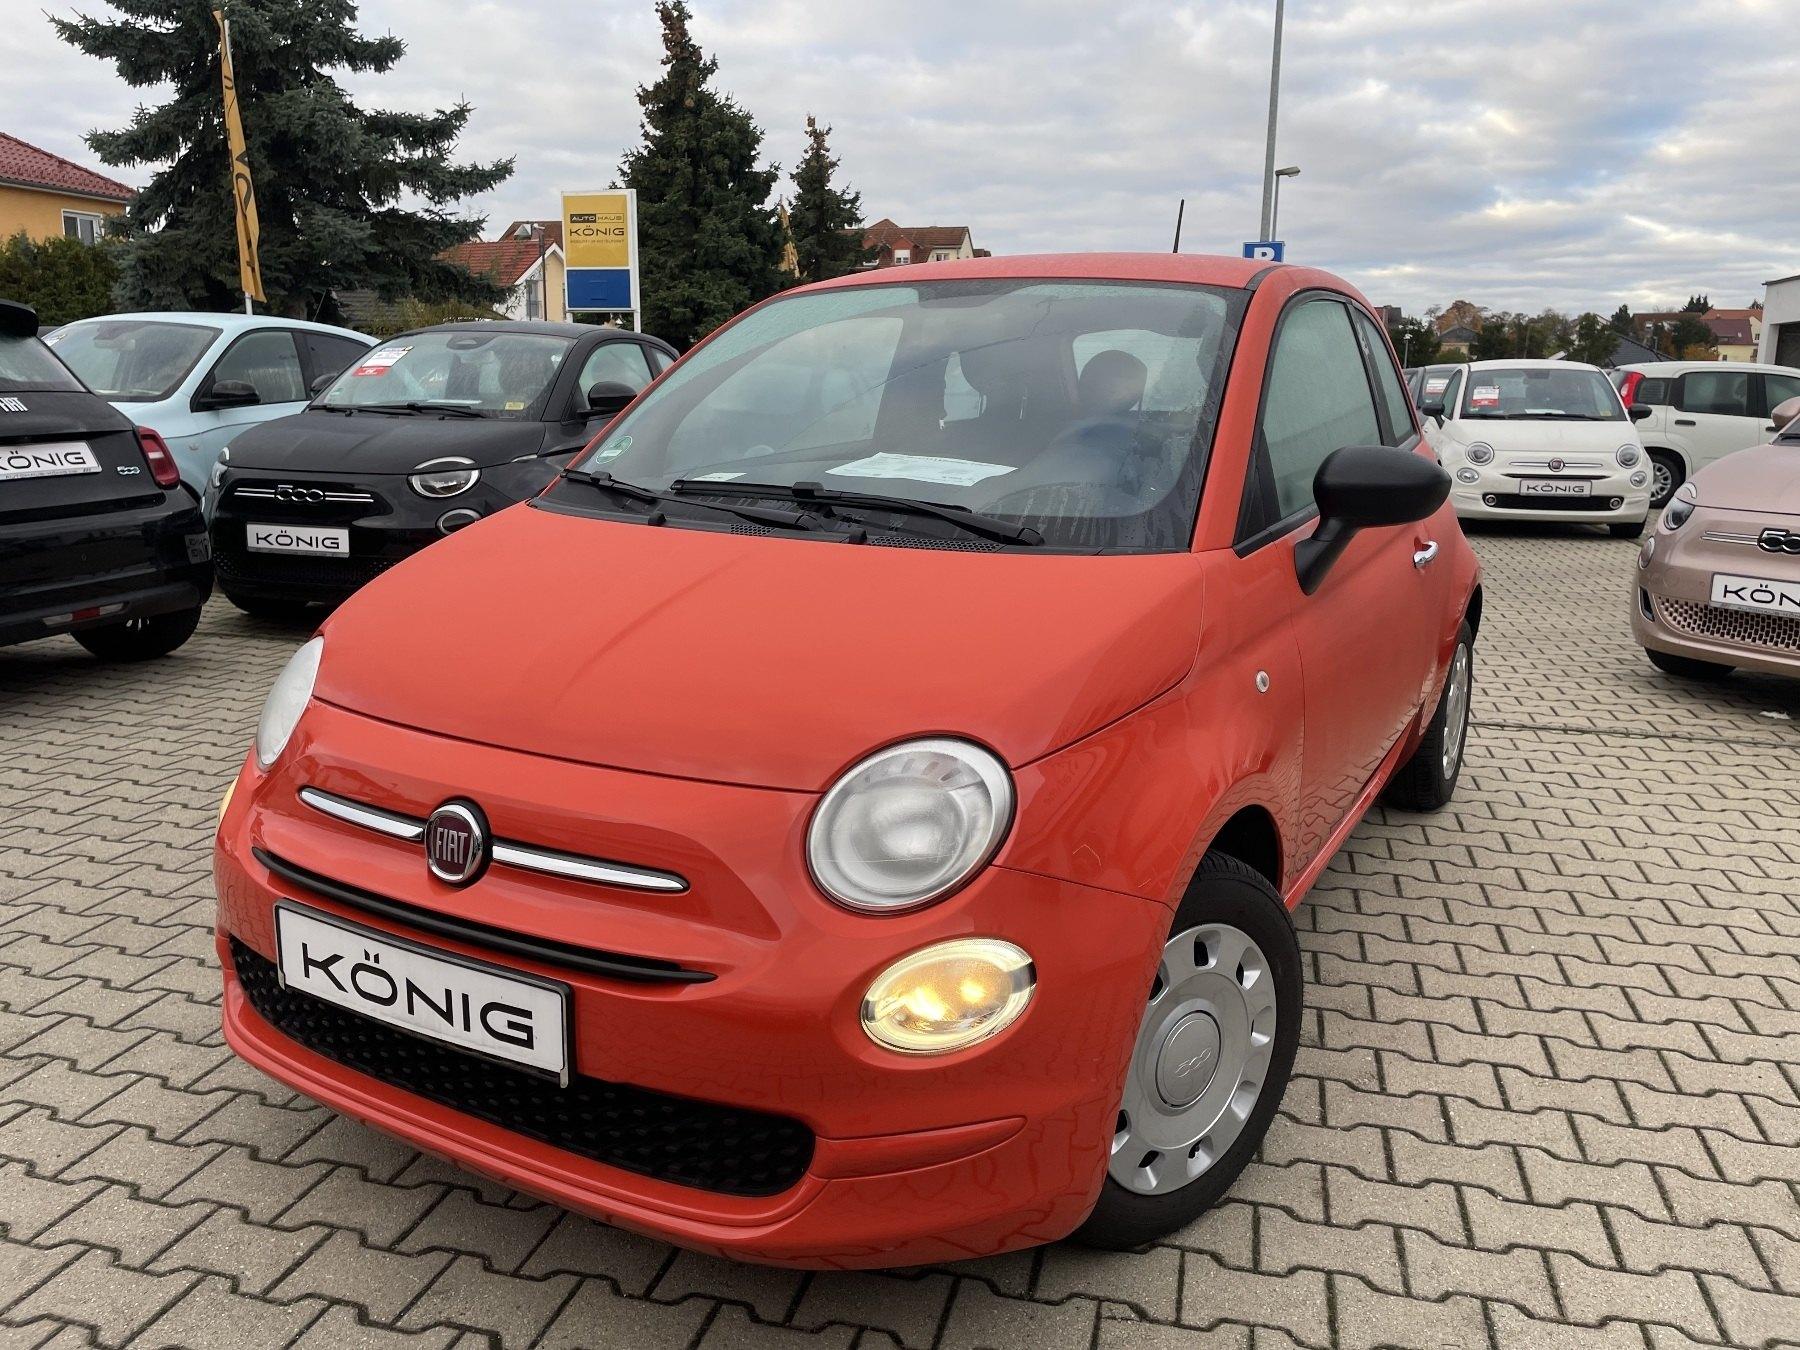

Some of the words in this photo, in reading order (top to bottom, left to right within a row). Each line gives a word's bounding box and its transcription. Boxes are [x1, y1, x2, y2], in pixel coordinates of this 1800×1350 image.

[569, 225, 625, 237] KÖNIG
[276, 484, 324, 502] 500
[1526, 482, 1585, 493] KÖNIG
[255, 529, 340, 550] KÖNIG
[435, 827, 469, 865] FIAT
[301, 941, 535, 1051] KÖNIG
